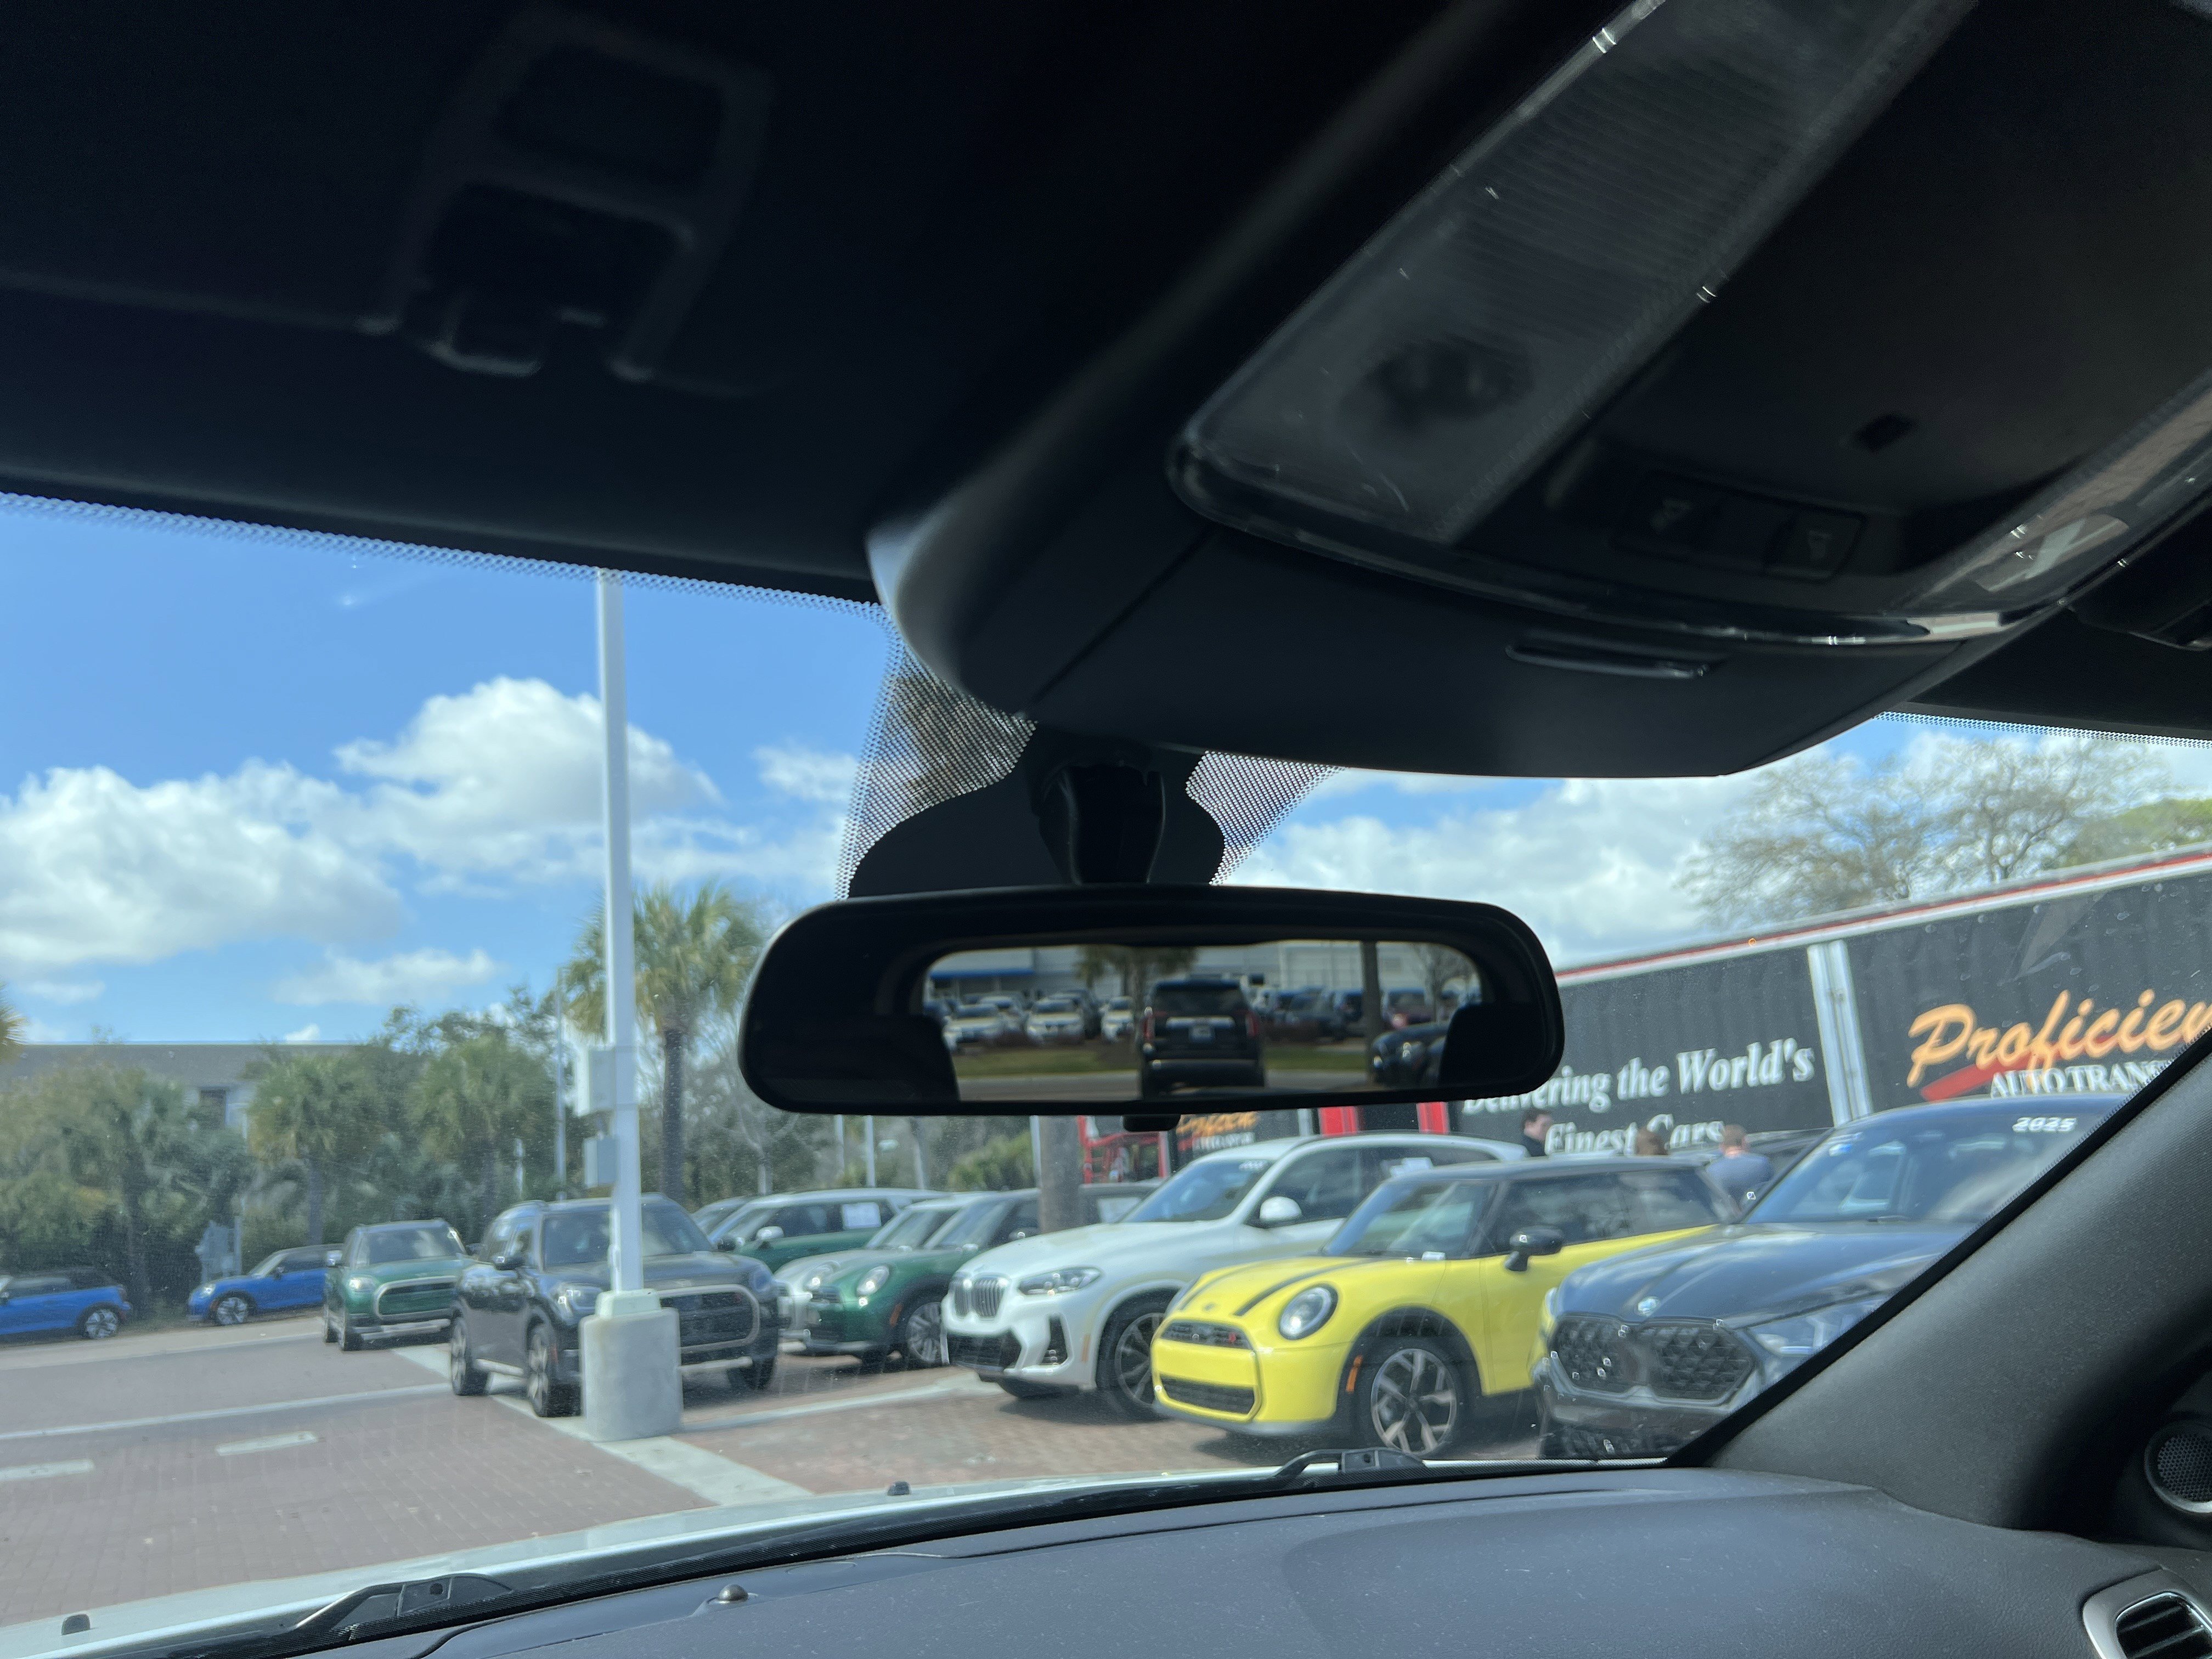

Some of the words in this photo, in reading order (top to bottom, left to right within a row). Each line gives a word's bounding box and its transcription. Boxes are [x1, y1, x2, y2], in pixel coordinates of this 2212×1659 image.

[1617, 1057, 1671, 1101] the
[1676, 1037, 1815, 1094] World's
[1544, 1121, 1638, 1155] Finest
[2012, 1116, 2078, 1133] 2025
